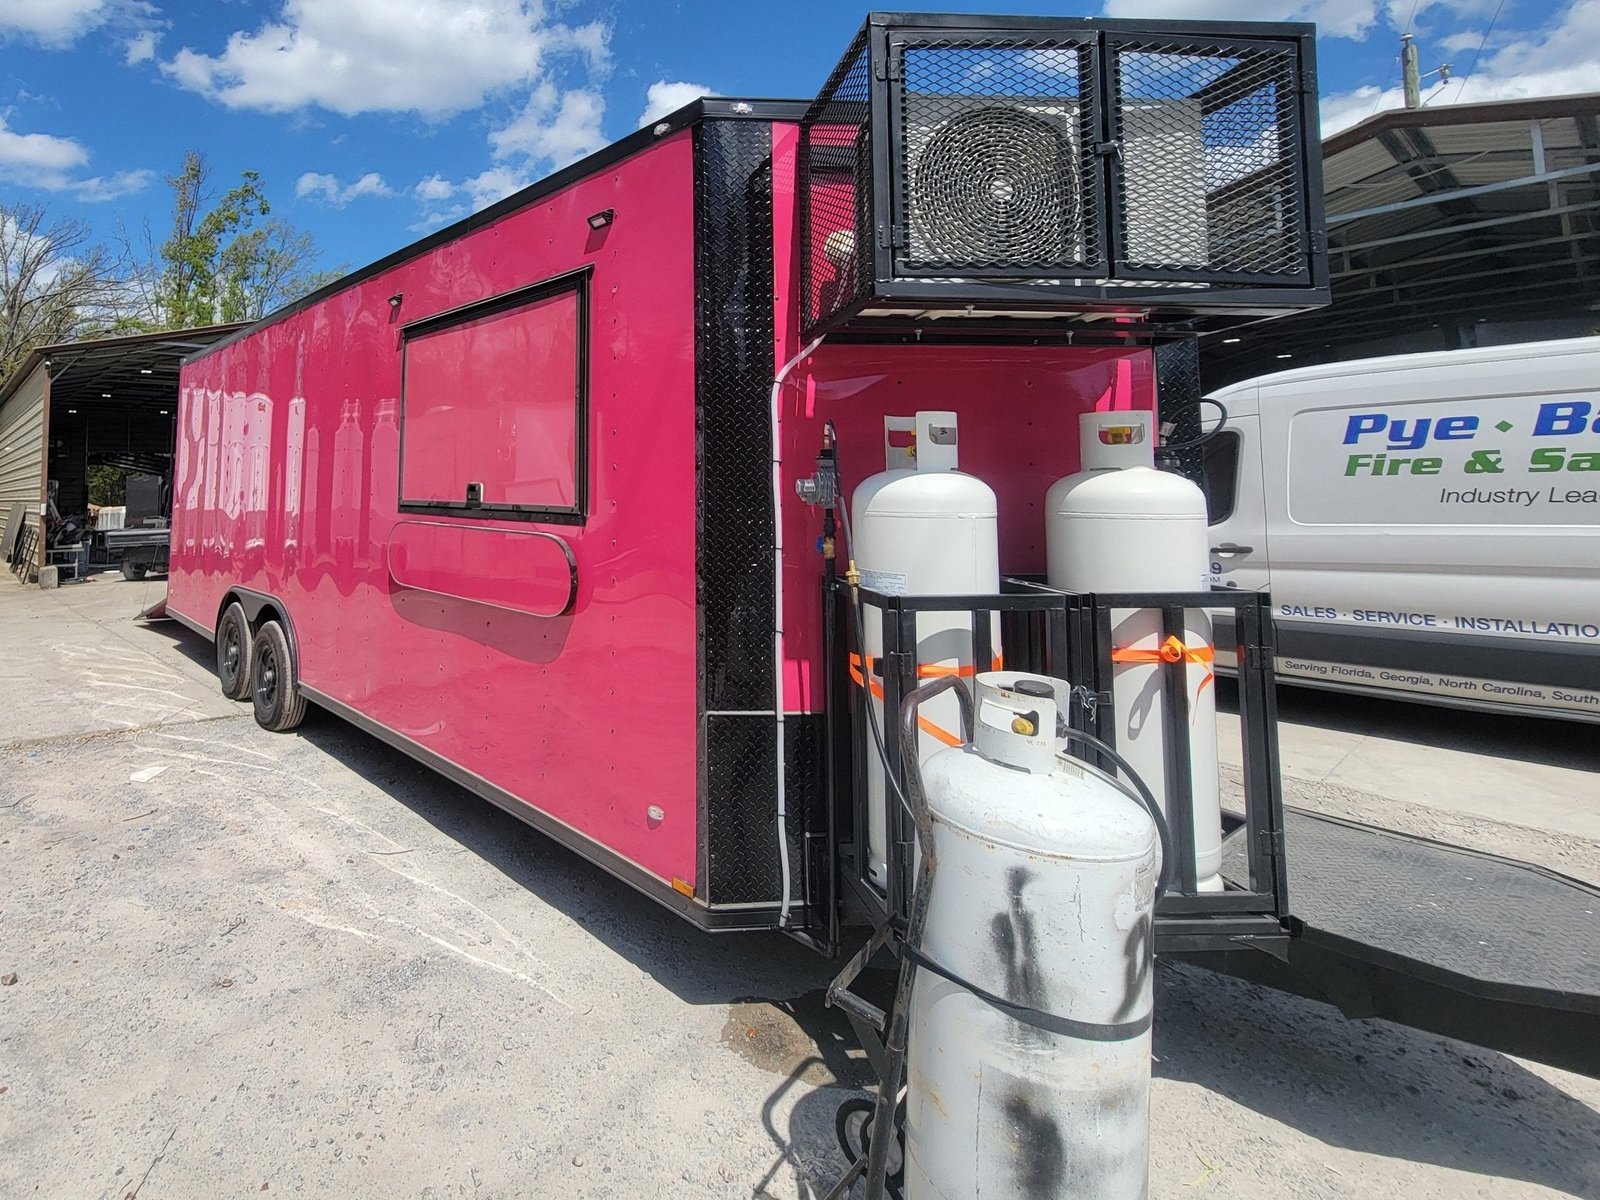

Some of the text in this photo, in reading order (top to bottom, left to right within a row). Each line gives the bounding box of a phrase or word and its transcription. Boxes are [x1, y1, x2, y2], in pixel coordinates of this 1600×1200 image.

[1342, 402, 1600, 450] Pye B
[1344, 454, 1443, 476] Fire
[1463, 450, 1504, 474] &
[1440, 486, 1600, 507] Industry Lea
[1280, 604, 1337, 619] SALES
[1352, 609, 1437, 627] SERVICE
[1285, 660, 1600, 705] Serving Florida, Georgia, North Carolina, South
